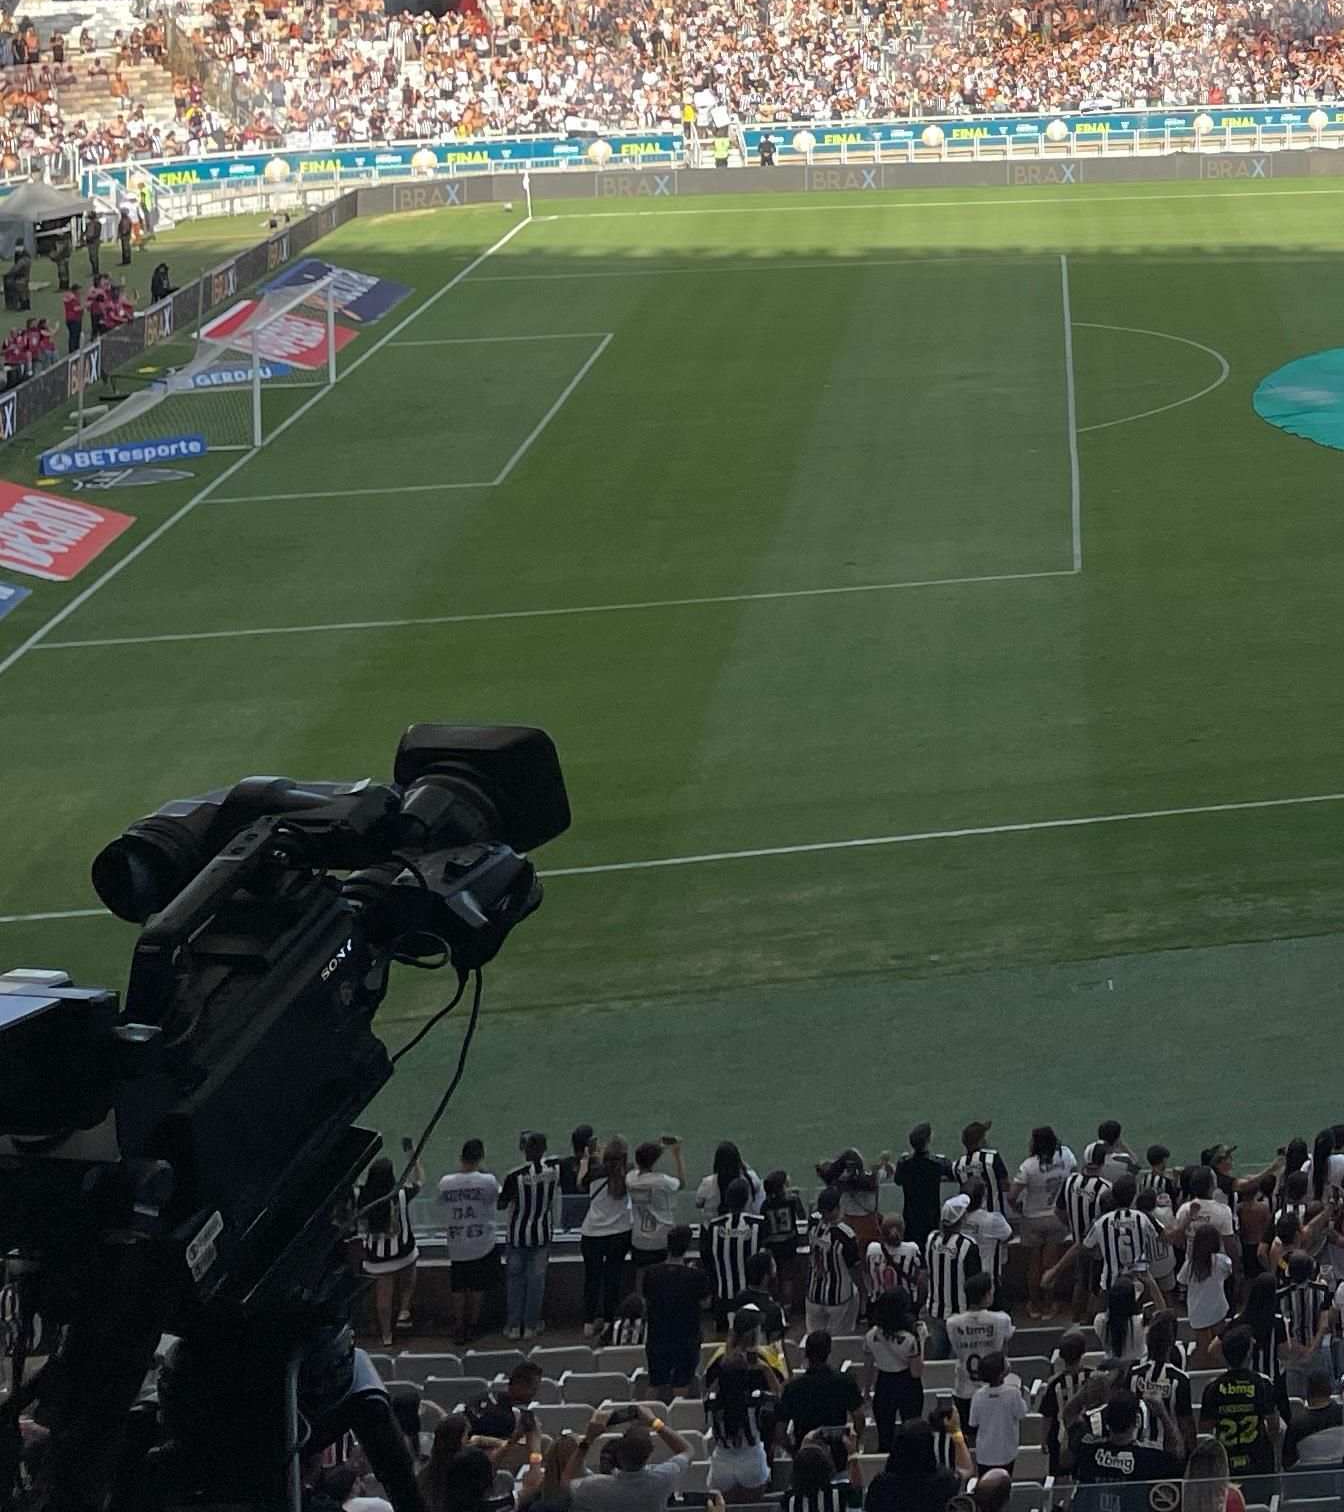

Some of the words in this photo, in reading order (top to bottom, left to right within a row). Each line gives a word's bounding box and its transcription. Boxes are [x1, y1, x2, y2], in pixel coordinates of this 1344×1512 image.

[447, 152, 489, 164] FINAL
[621, 143, 664, 155] FINAL
[300, 159, 345, 172] FINAL
[1015, 163, 1076, 185] BRAX
[1207, 158, 1266, 179] BRAX
[603, 175, 670, 198] BRAX
[812, 169, 877, 190] BRAX
[401, 183, 460, 209] BRAX
[74, 438, 202, 469] BETesporte
[320, 937, 354, 982] SONY
[1229, 1382, 1256, 1399] bmg
[1105, 1451, 1135, 1475] bmg
